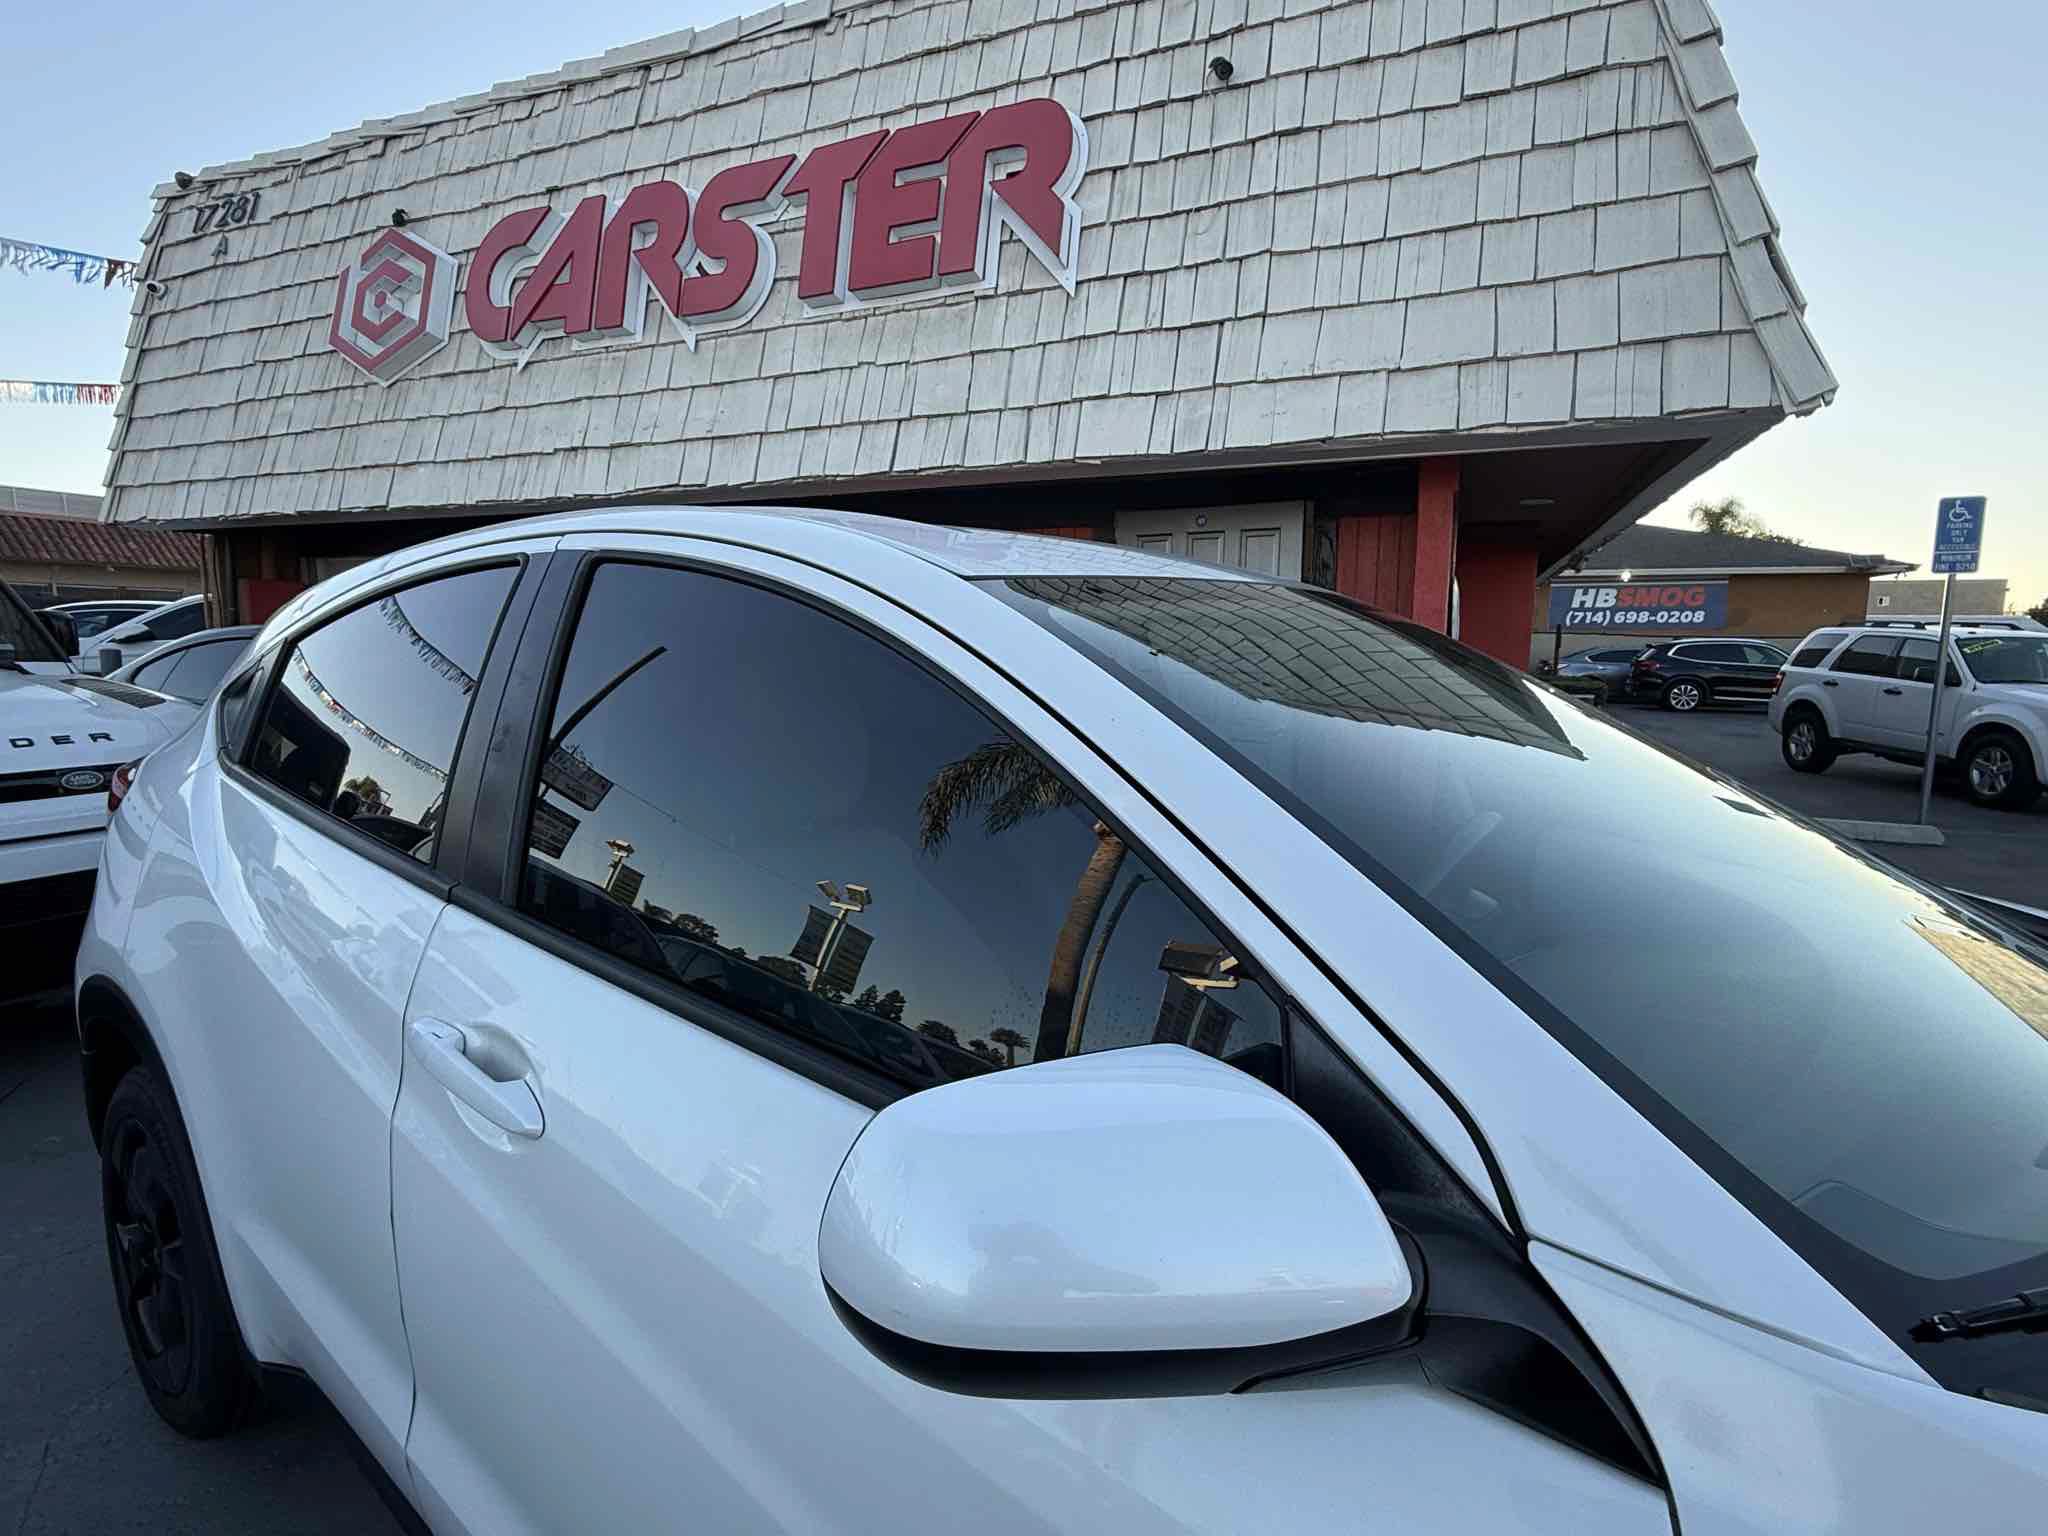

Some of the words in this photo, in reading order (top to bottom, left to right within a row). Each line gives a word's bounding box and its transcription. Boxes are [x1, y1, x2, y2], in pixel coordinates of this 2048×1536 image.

[192, 192, 260, 234] 17281
[211, 234, 229, 257] A
[465, 98, 1086, 362] CARSTER
[1565, 610, 1610, 626] (714)
[1614, 611, 1706, 624] 698-0208
